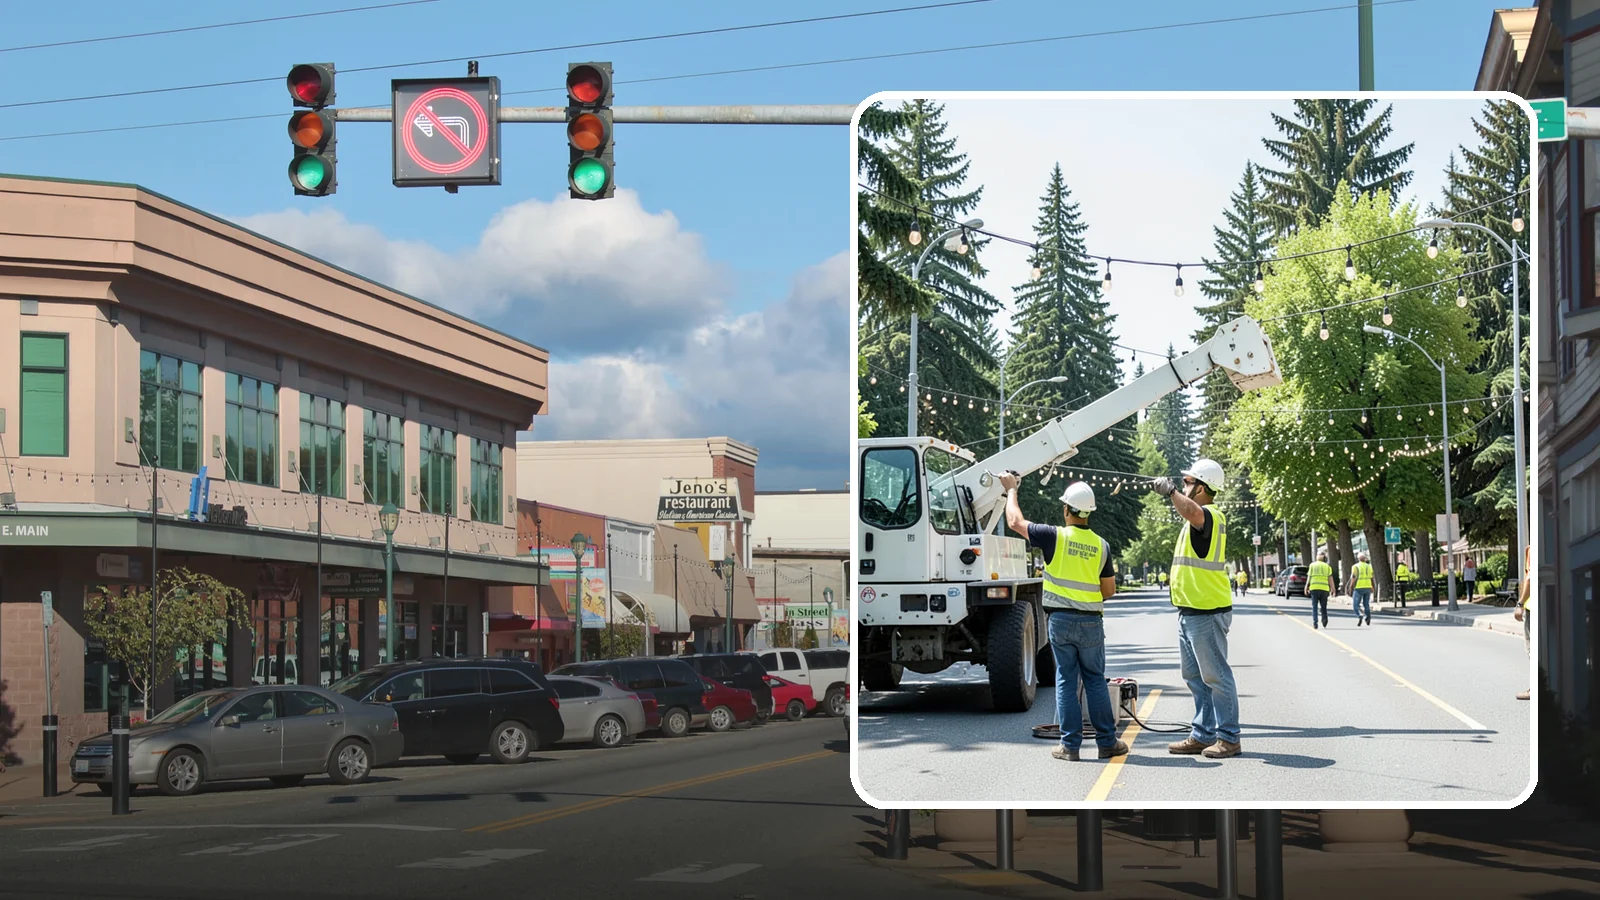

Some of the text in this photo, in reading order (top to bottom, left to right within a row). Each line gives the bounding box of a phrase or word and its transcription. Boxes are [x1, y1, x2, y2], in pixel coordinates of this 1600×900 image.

[670, 480, 727, 494] Jeno's
[665, 496, 731, 509] restaurant
[659, 510, 681, 519] Italian
[686, 510, 714, 519] American
[715, 509, 737, 519] Cuisine
[2, 525, 49, 536] E. MAIN
[798, 607, 828, 617] Street
[791, 619, 823, 627] lass
